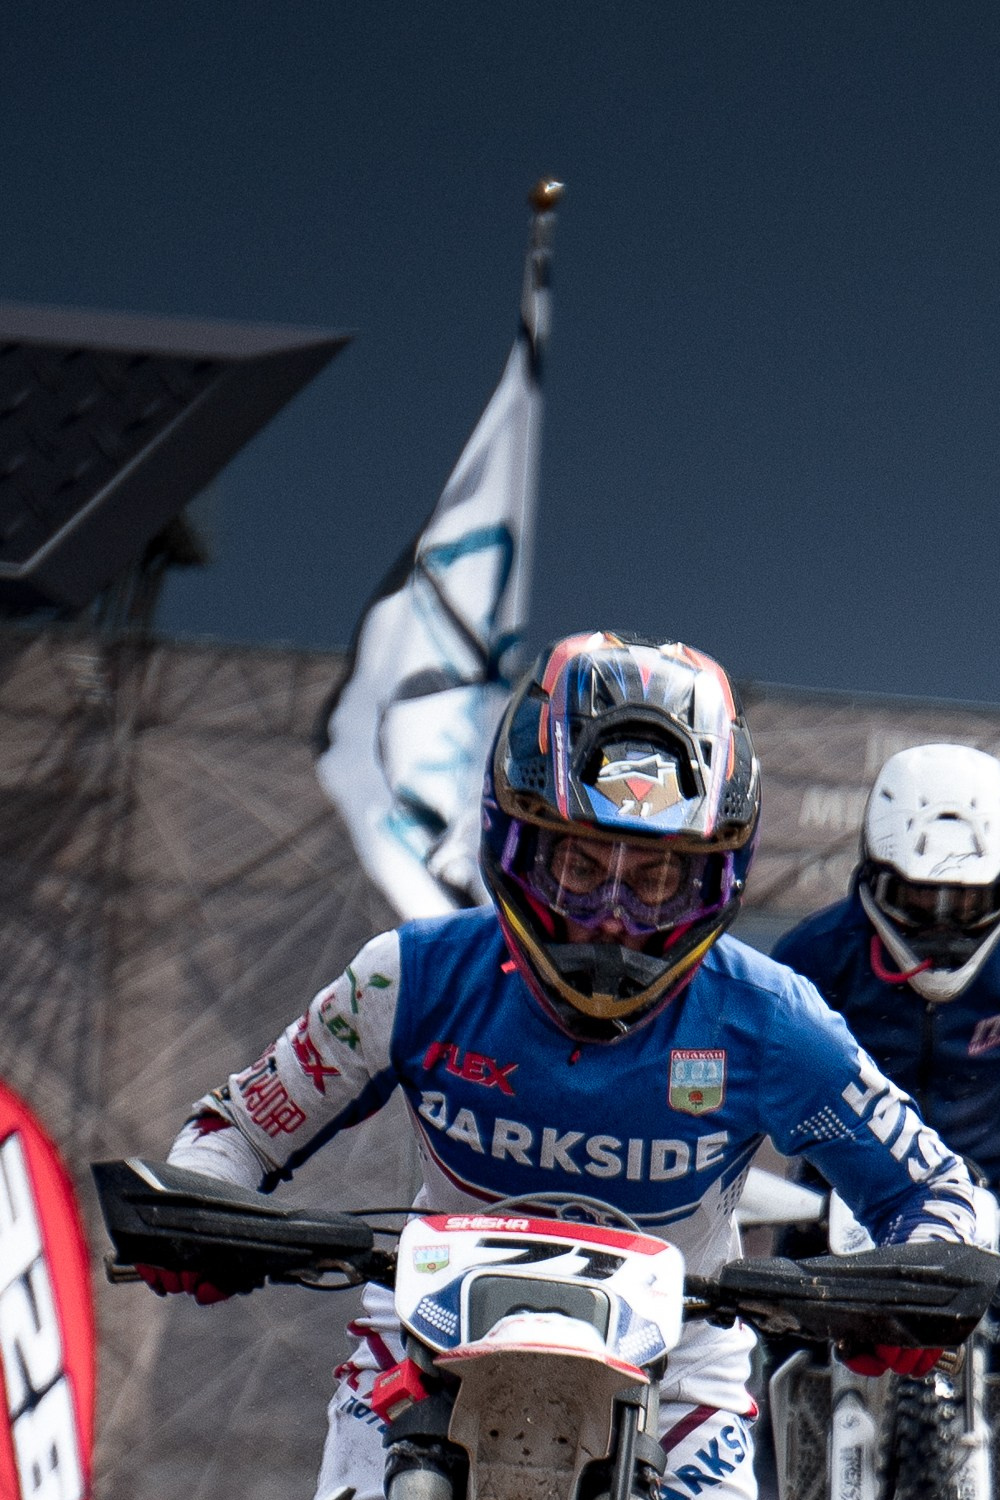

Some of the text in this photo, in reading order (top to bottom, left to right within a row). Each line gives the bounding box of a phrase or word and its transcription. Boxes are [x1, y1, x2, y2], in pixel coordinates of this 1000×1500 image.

[422, 1041, 518, 1096] FLEX
[418, 1090, 729, 1183] DARKSIDE
[445, 1217, 531, 1231] SHISHA
